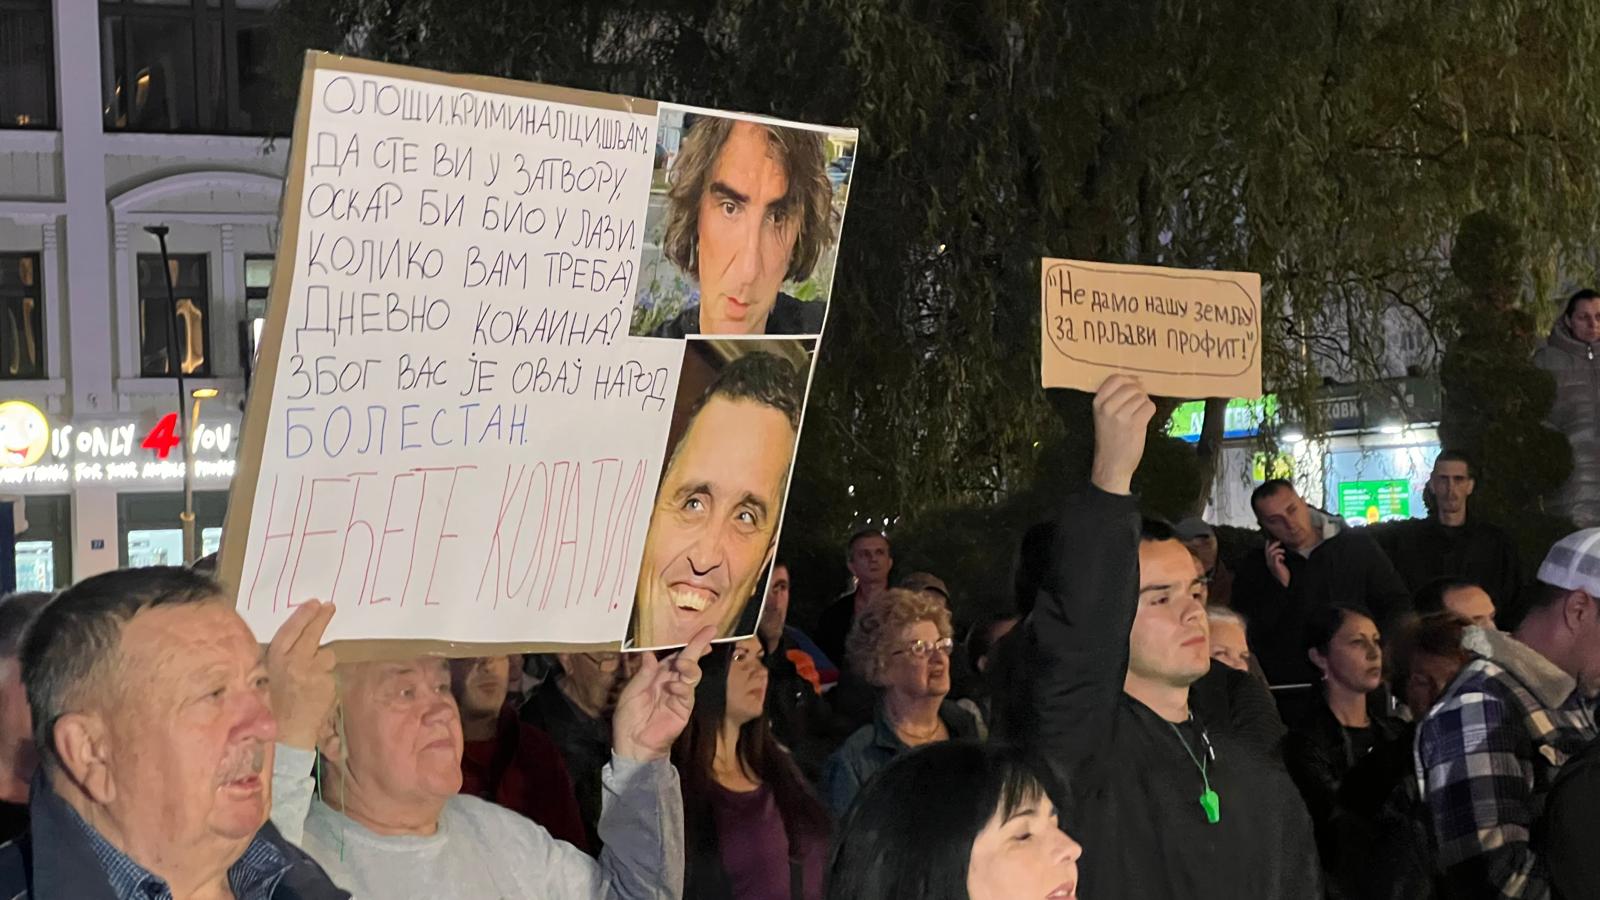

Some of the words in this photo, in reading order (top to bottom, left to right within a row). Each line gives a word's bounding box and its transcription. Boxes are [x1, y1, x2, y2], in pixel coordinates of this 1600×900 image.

[310, 132, 359, 176] ДА
[373, 137, 418, 175] СТЕ
[433, 143, 472, 181] ВИ
[484, 153, 500, 187] У
[307, 182, 402, 223] ОСКАР
[419, 189, 465, 227] БИ
[482, 196, 546, 235] БИО
[553, 206, 567, 240] У
[572, 209, 636, 251] ЛАЗИ.
[307, 230, 444, 283] КОЛИКО
[463, 246, 528, 290] ВАМ
[296, 285, 450, 353] ДНЕВНО
[473, 301, 622, 347] КОКАИНА?
[1084, 320, 1157, 347] прљави
[1092, 290, 1139, 314] дамо
[1145, 295, 1188, 318] нашу
[1194, 301, 1254, 327] земљу
[287, 354, 384, 400] ЗБОГ
[399, 353, 448, 391] ВАС
[594, 360, 669, 412] НАРОД
[51, 425, 73, 458] IS
[76, 423, 135, 457] ONLY
[141, 412, 181, 459] 4
[286, 403, 529, 459] БОЛЕСТАН.
[247, 464, 478, 613] НЕЋЕТЕ
[476, 457, 649, 612] КОПАТИ!
